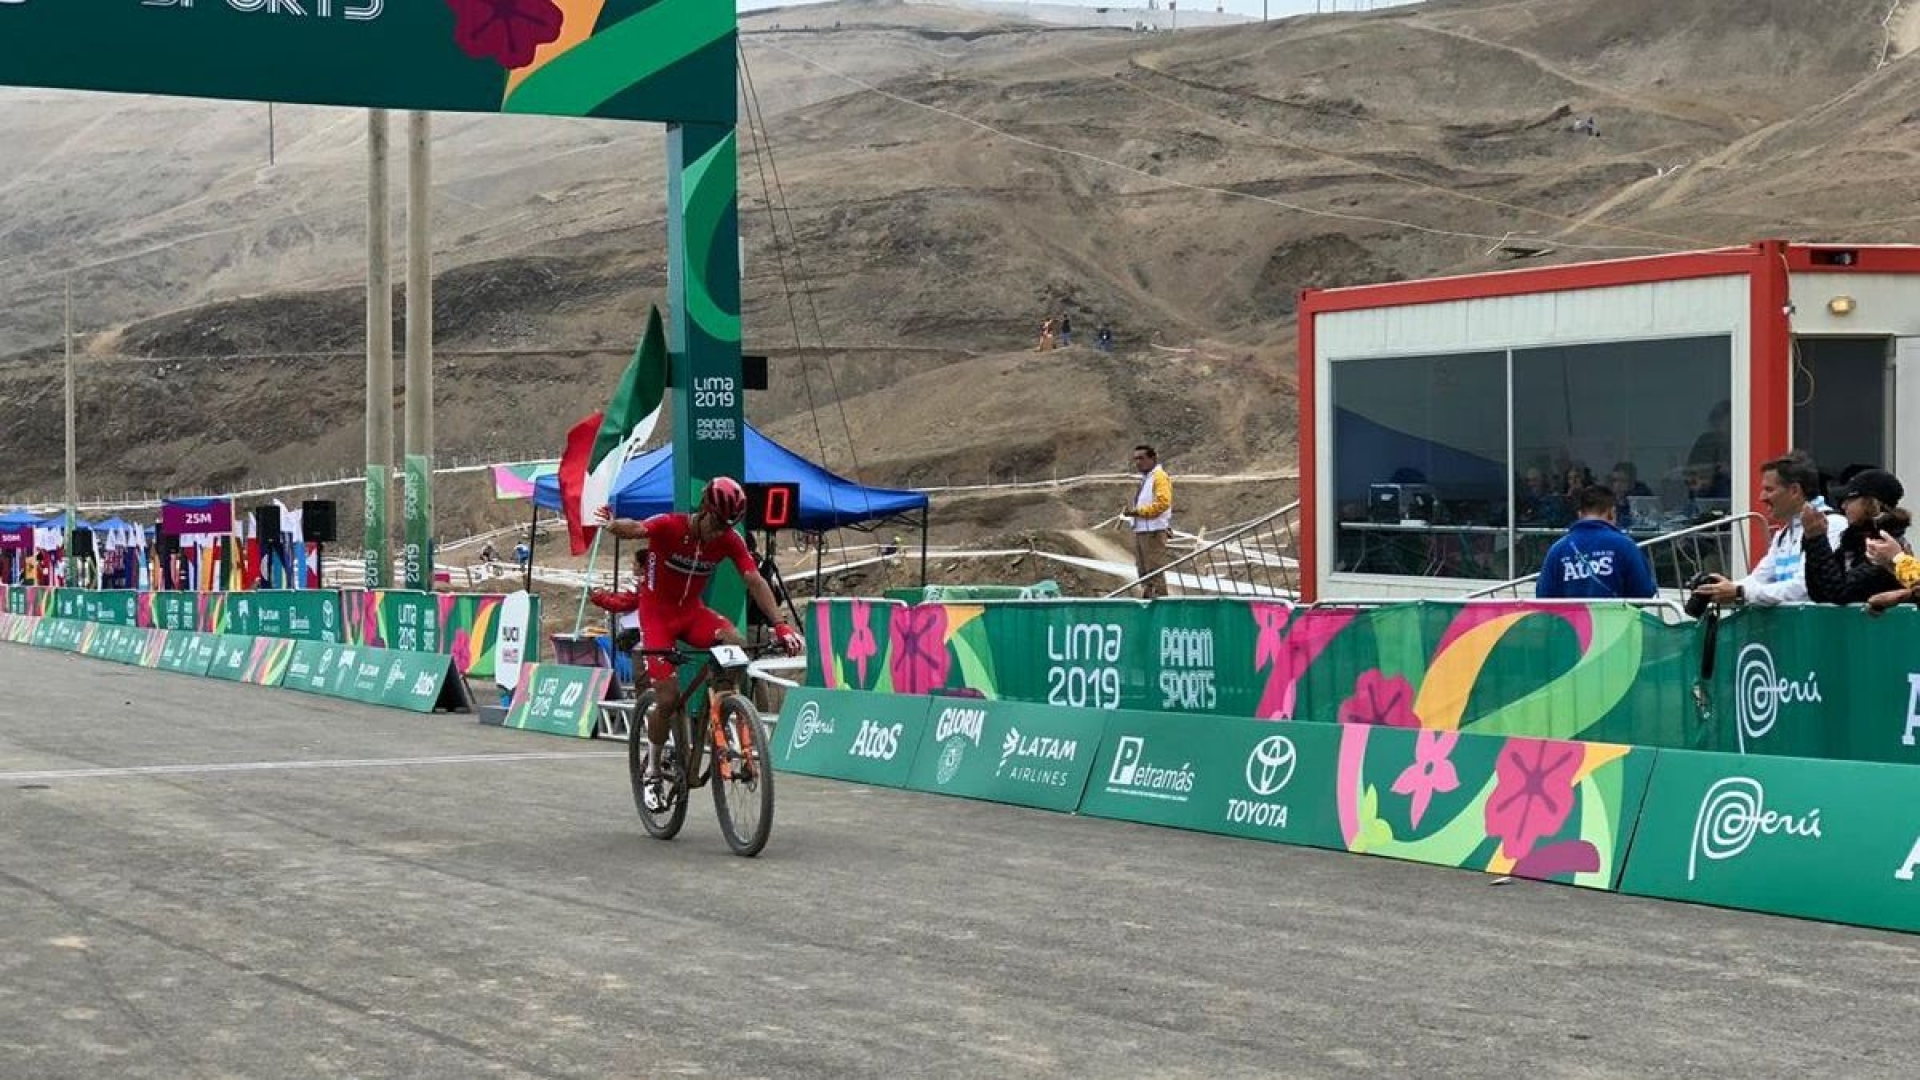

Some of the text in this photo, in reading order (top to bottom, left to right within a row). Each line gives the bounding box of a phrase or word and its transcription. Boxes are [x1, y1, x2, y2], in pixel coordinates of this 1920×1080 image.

[695, 392, 735, 407] 2019
[185, 513, 212, 524] 25M
[766, 488, 789, 525] 0
[406, 543, 420, 583] 2019
[724, 648, 737, 660] 2
[1048, 666, 1121, 709] 2019
[936, 707, 985, 748] GLORIA
[1016, 735, 1077, 761] LATAM
[1009, 767, 1068, 787] AIRLINES
[1109, 736, 1195, 793] Petramás
[1227, 799, 1288, 828] TOYOTA
